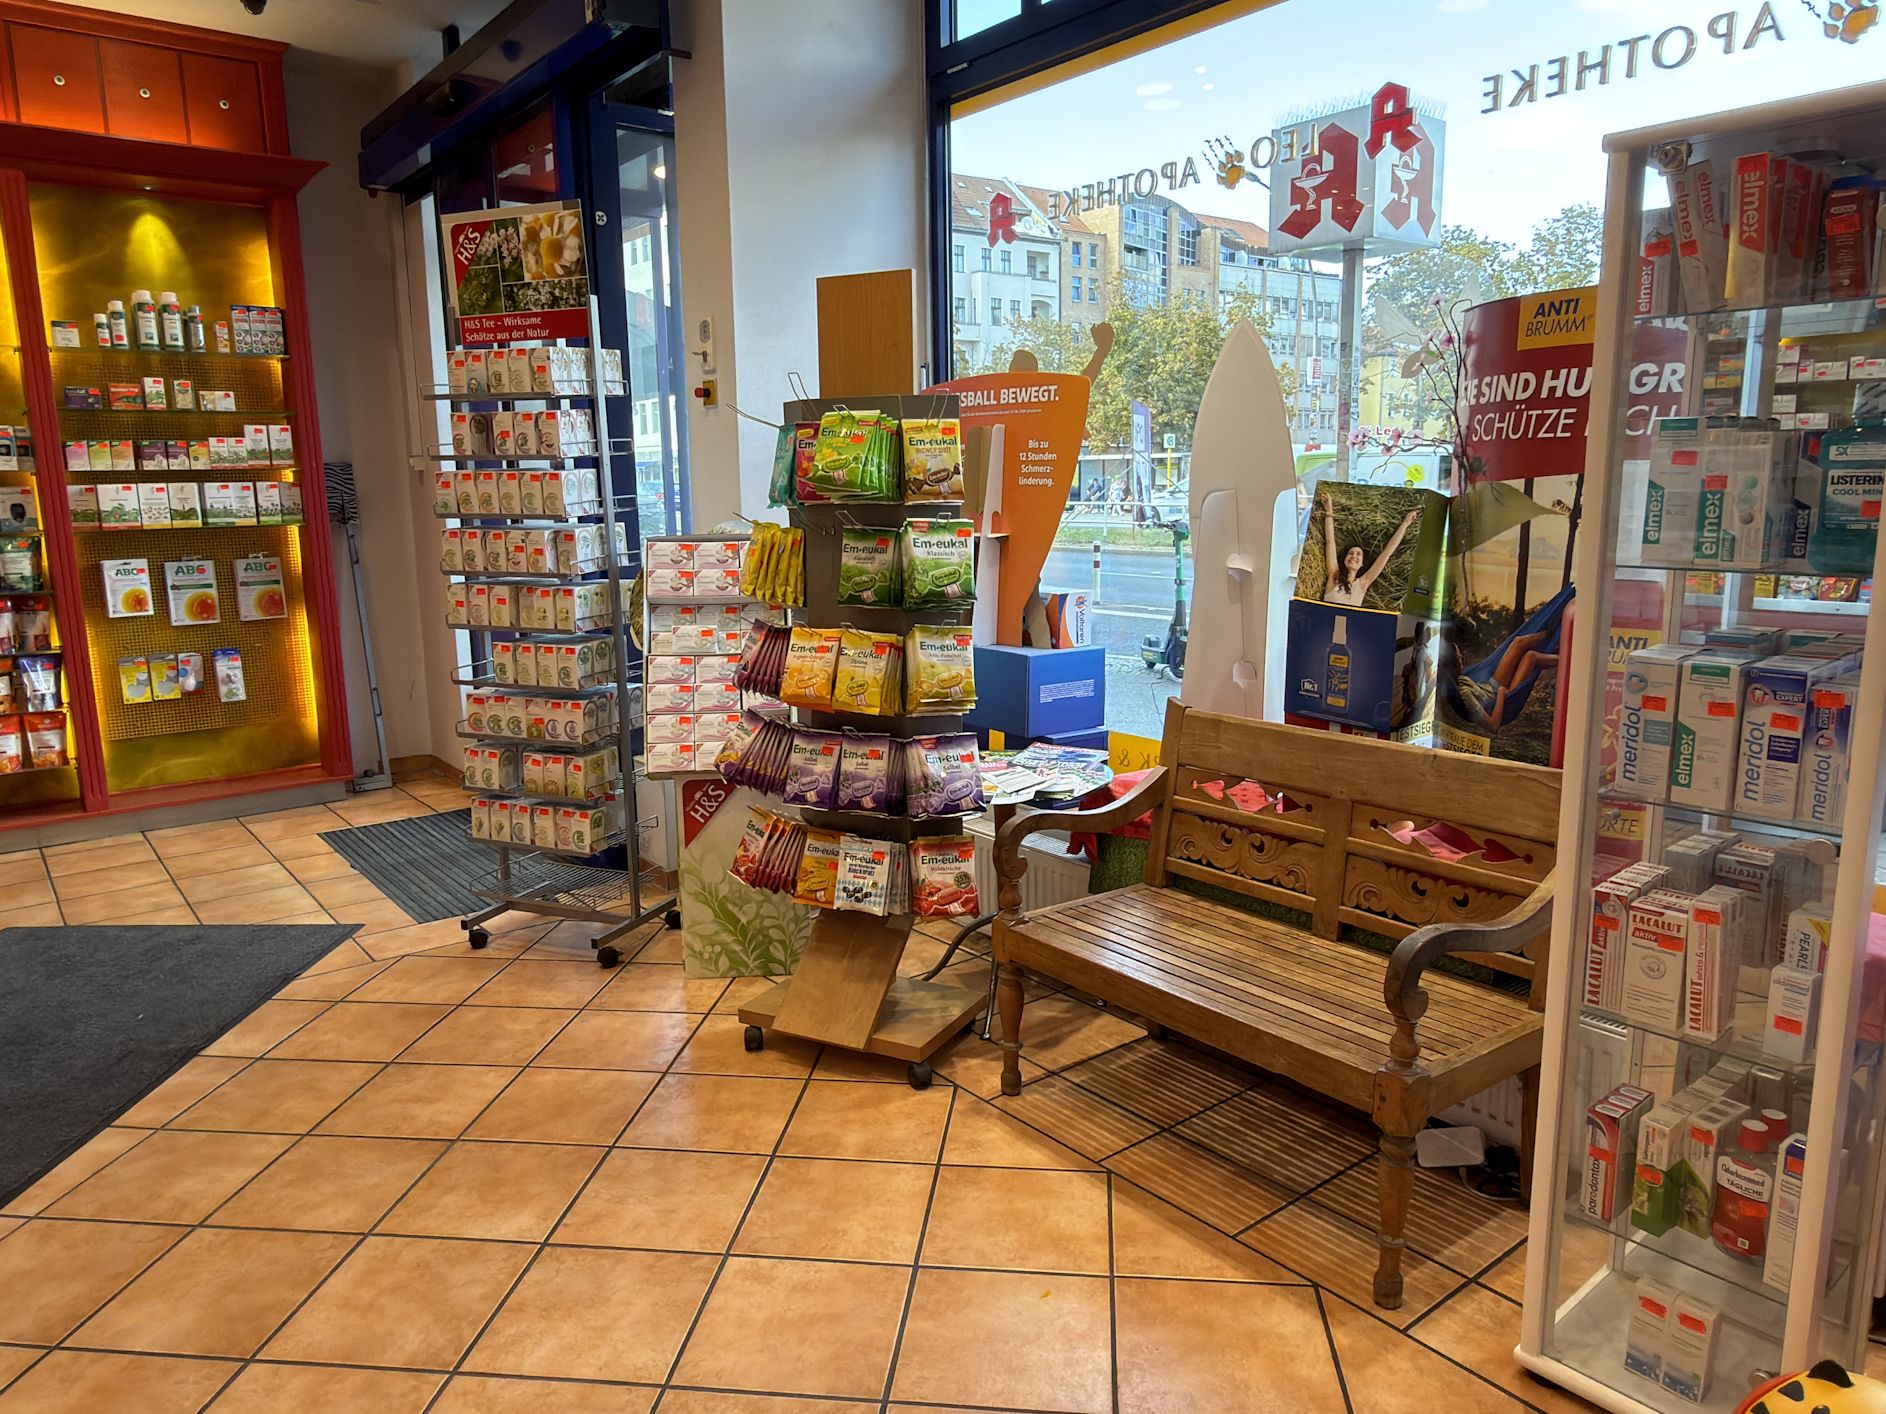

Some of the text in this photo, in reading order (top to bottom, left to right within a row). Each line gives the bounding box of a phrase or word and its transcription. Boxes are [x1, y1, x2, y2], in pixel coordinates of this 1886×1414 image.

[1675, 180, 1694, 241] elmex
[1697, 171, 1715, 226] elmex
[1742, 170, 1767, 240] elmex
[456, 227, 481, 265] H&S
[1638, 265, 1653, 312] elmex
[464, 319, 480, 330] H&S
[482, 318, 495, 328] Tee
[503, 316, 542, 326] Wirksame
[1533, 298, 1581, 319] ANTI
[465, 328, 550, 342] Schätze aus der Natur
[1525, 318, 1587, 338] BRUMM
[959, 385, 1060, 408] SBALL BEWEGT.
[1479, 371, 1537, 405] SIND
[1472, 403, 1578, 442] SCHÜTZE
[909, 436, 958, 447] Em-eukal
[1019, 452, 1057, 461] 12 Stunden
[1028, 439, 1049, 448] Bis zu
[1018, 476, 1055, 487] linderung.
[1020, 464, 1054, 473] Schmerz-
[1830, 474, 1885, 486] LISTERIN
[1832, 488, 1885, 496] COOL MIN
[1647, 489, 1663, 542] elmex
[1701, 491, 1722, 555] elmex
[1792, 508, 1809, 557] elmex
[912, 537, 968, 549] Em-eukal
[1622, 702, 1643, 782] meridol
[1678, 733, 1695, 785] elmex
[1742, 720, 1767, 801] meridol
[689, 784, 726, 824] H&S
[1811, 750, 1833, 822] meridol
[806, 843, 840, 857] Em-euka
[1632, 913, 1685, 934] LACALUT
[1633, 928, 1657, 940] aktiv
[1587, 945, 1604, 1006] LACALUT
[1688, 978, 1703, 1032] LACALUT
[1588, 1158, 1601, 1216] parodontax
